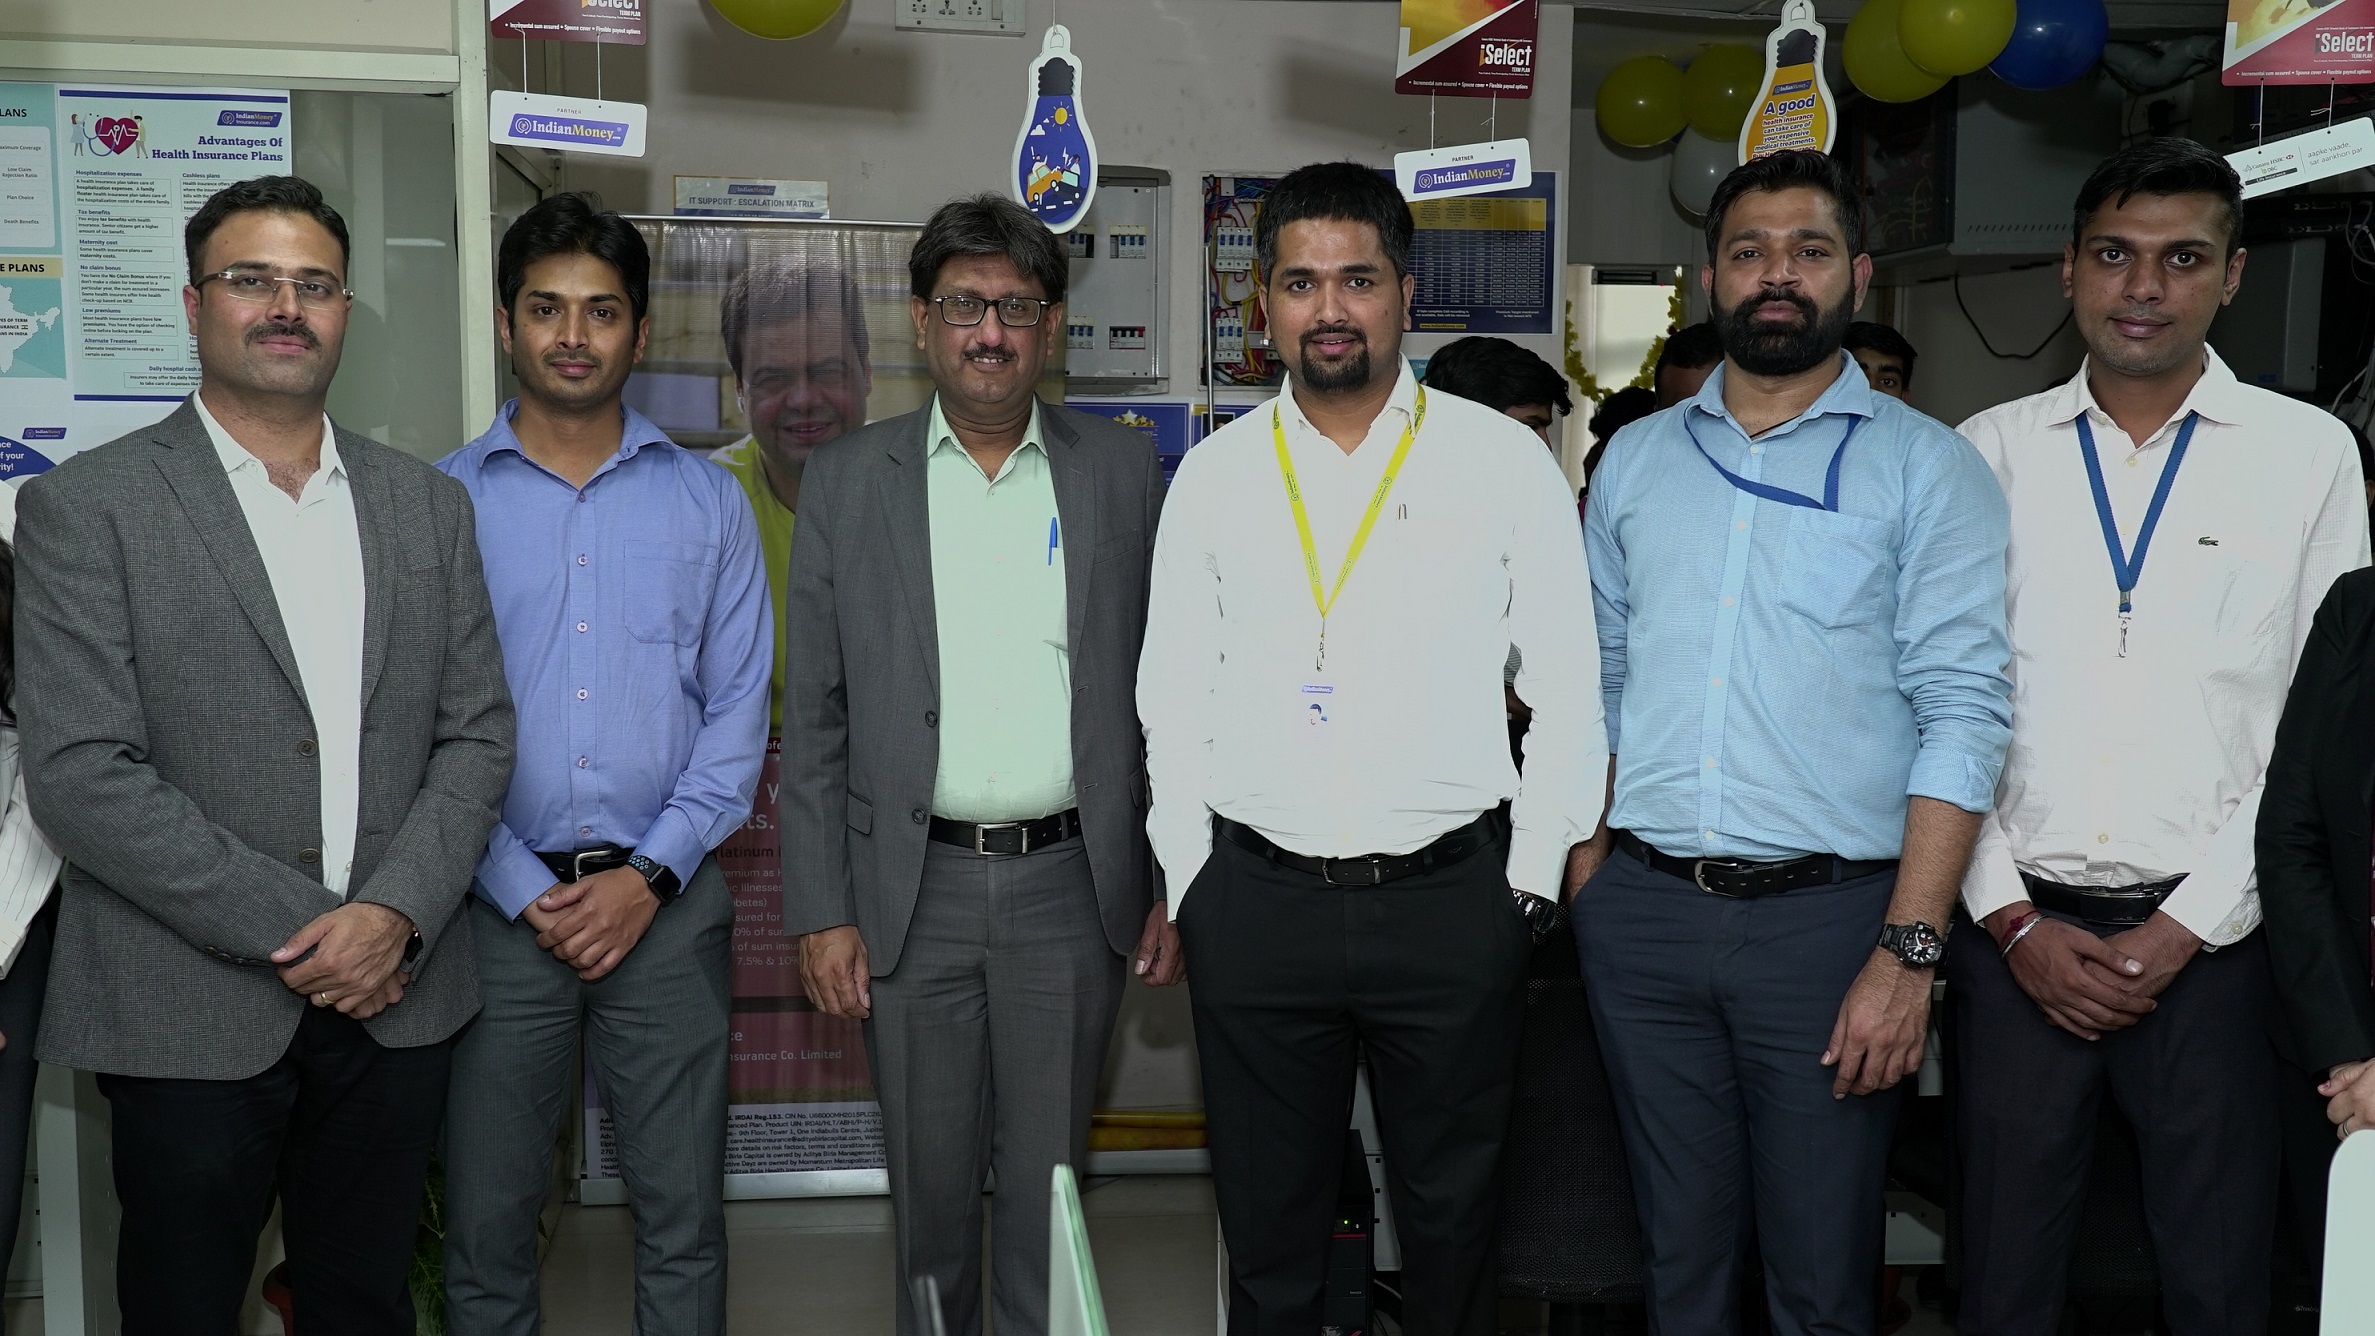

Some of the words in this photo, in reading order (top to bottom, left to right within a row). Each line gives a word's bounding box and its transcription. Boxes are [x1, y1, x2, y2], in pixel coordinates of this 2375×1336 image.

[2315, 32, 2374, 54] iSelect
[1479, 44, 1532, 66] iSelect
[1764, 102, 1775, 115] A
[1778, 94, 1815, 115] good
[0, 108, 27, 118] LANS
[1763, 118, 1782, 126] health
[1784, 114, 1813, 122] insurance
[1779, 130, 1809, 139] expensive
[198, 136, 266, 148] Advantages
[269, 137, 283, 147] Of
[1780, 138, 1815, 147] treatments.
[152, 150, 189, 159] Health
[192, 150, 248, 160] Insurance
[251, 152, 283, 161] Plans
[2307, 148, 2328, 158] aapke
[2321, 151, 2350, 163] aankhon
[2352, 148, 2363, 156] par
[698, 197, 732, 205] SUPPORT
[739, 199, 786, 207] ESCALATION
[8, 264, 45, 272] PLANS
[720, 846, 773, 858] latinum
[735, 898, 767, 907] betes)
[736, 912, 763, 921] sured
[767, 912, 780, 921] for
[754, 927, 765, 936] of
[738, 942, 748, 951] of
[752, 943, 772, 951] sum
[781, 1050, 797, 1060] Co.
[801, 1050, 842, 1059] Limited
